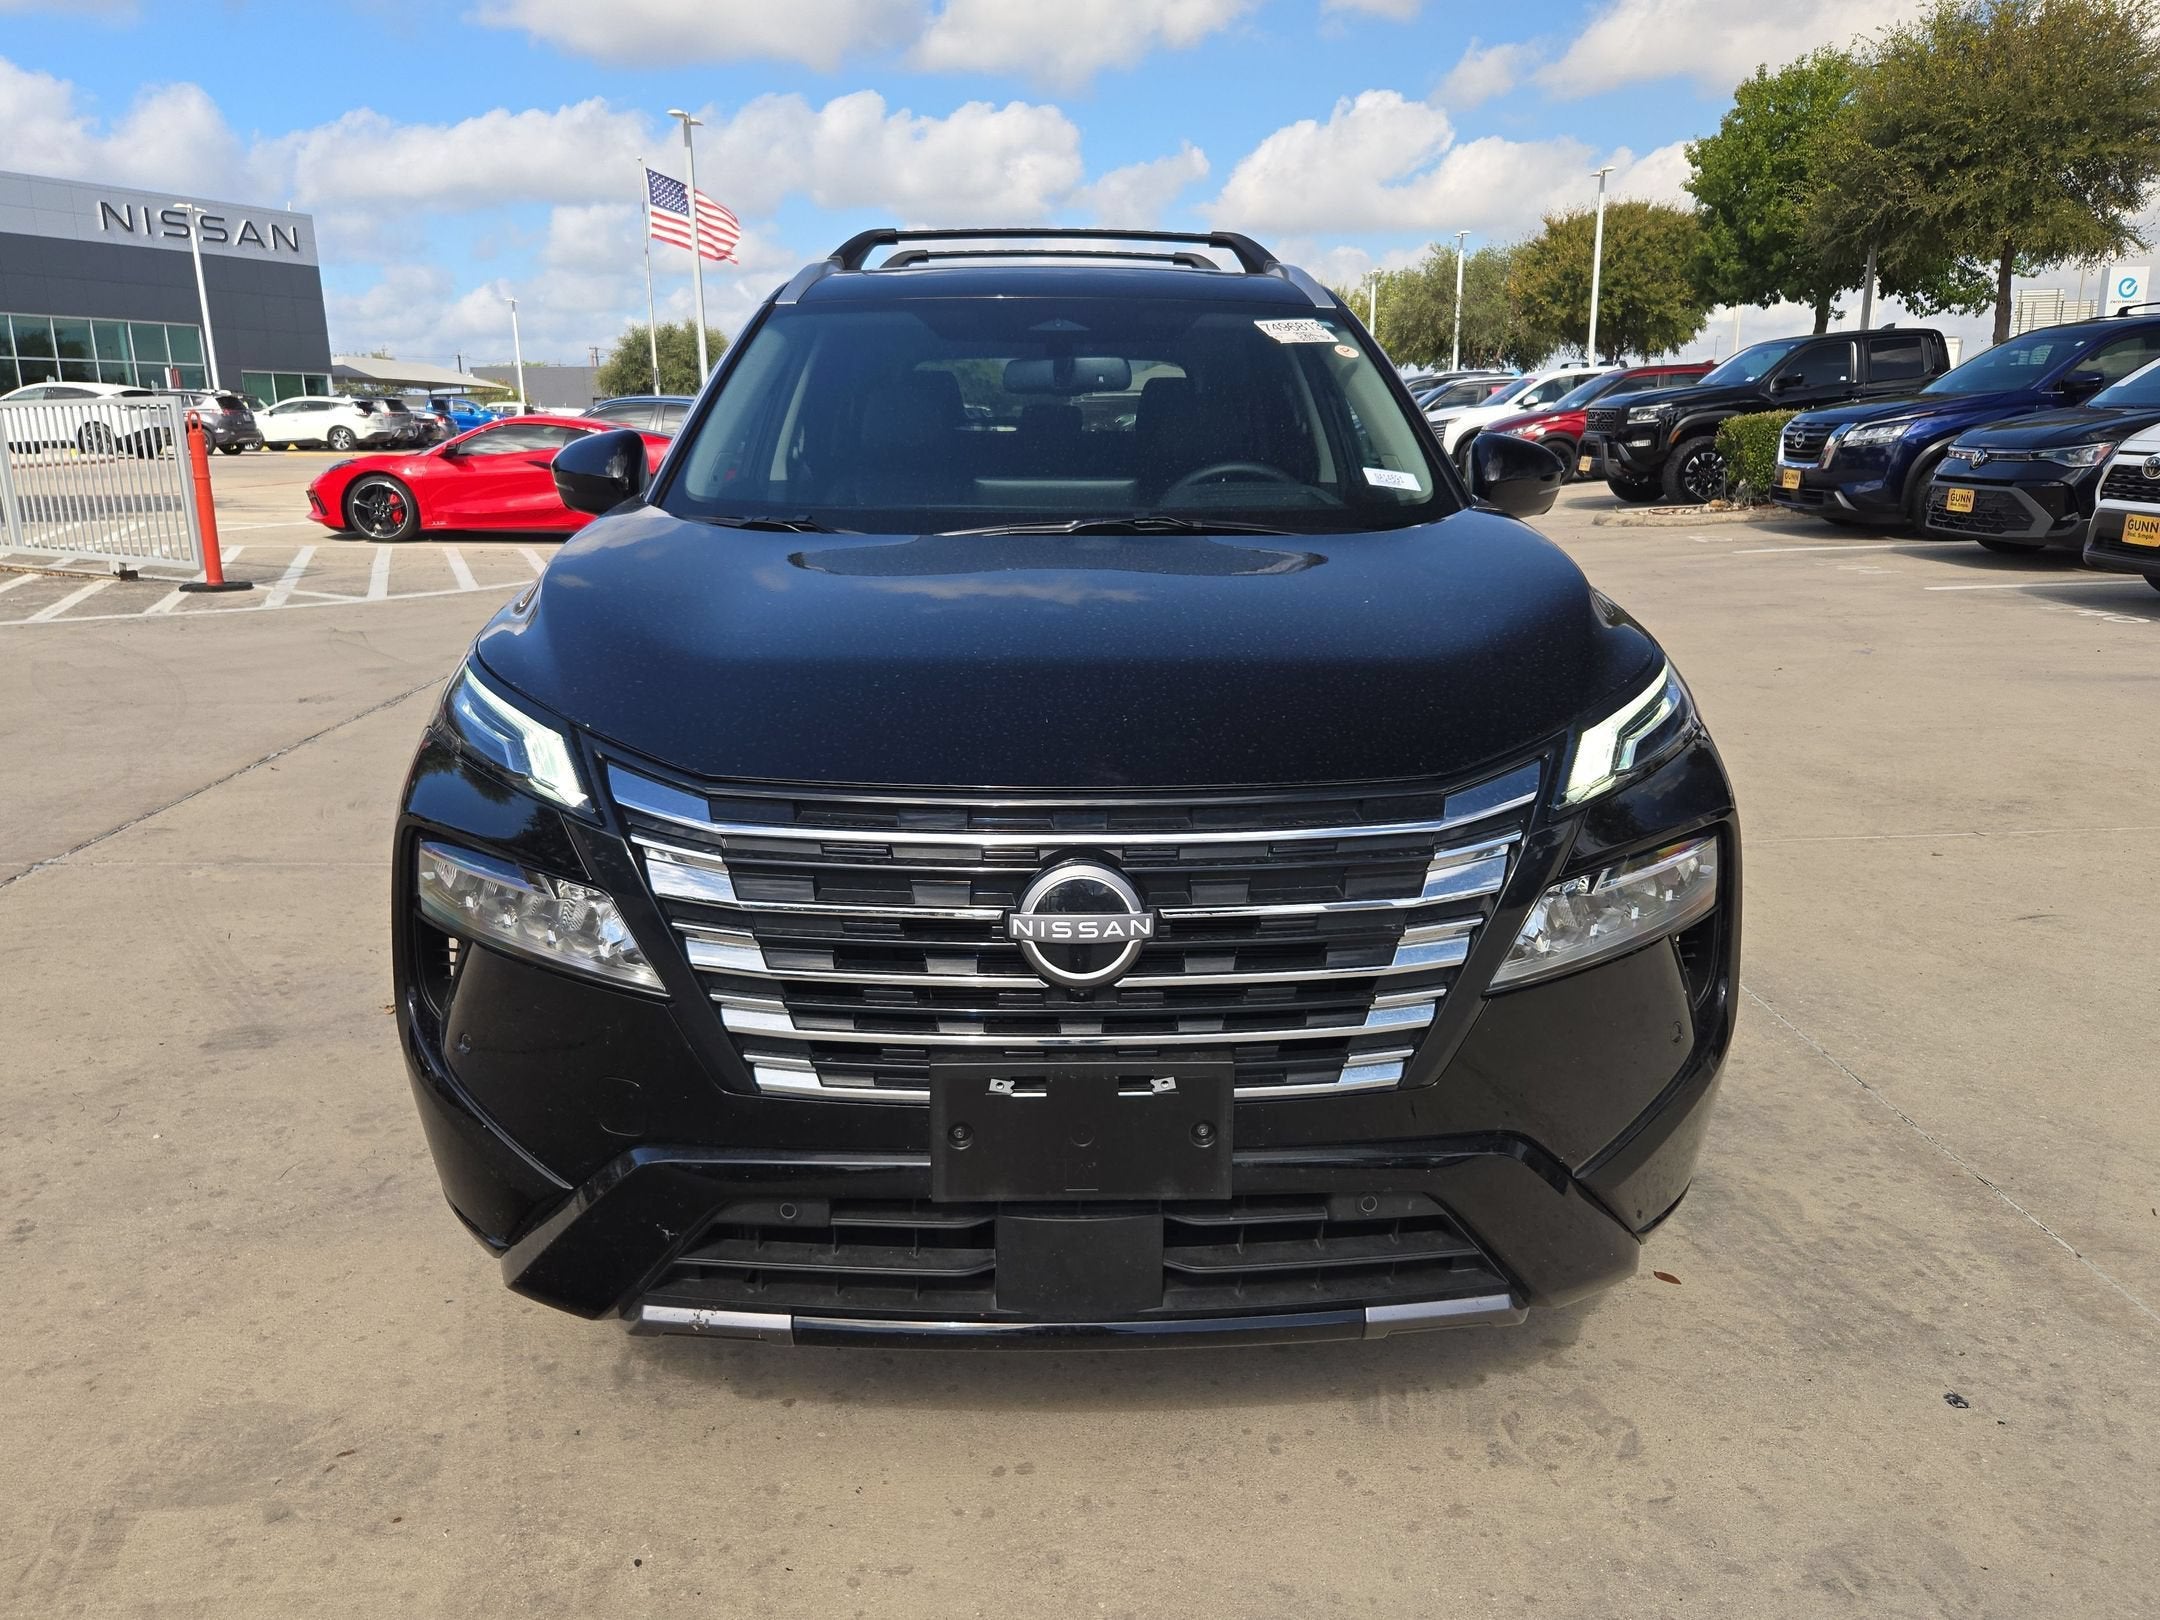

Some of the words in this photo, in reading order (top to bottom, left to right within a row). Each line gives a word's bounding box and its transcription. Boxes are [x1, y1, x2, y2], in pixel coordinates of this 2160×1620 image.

[99, 201, 300, 252] NISSAN
[1951, 493, 1972, 504] GUNN
[2128, 518, 2160, 533] GUNN
[1012, 918, 1151, 939] NISSAN
